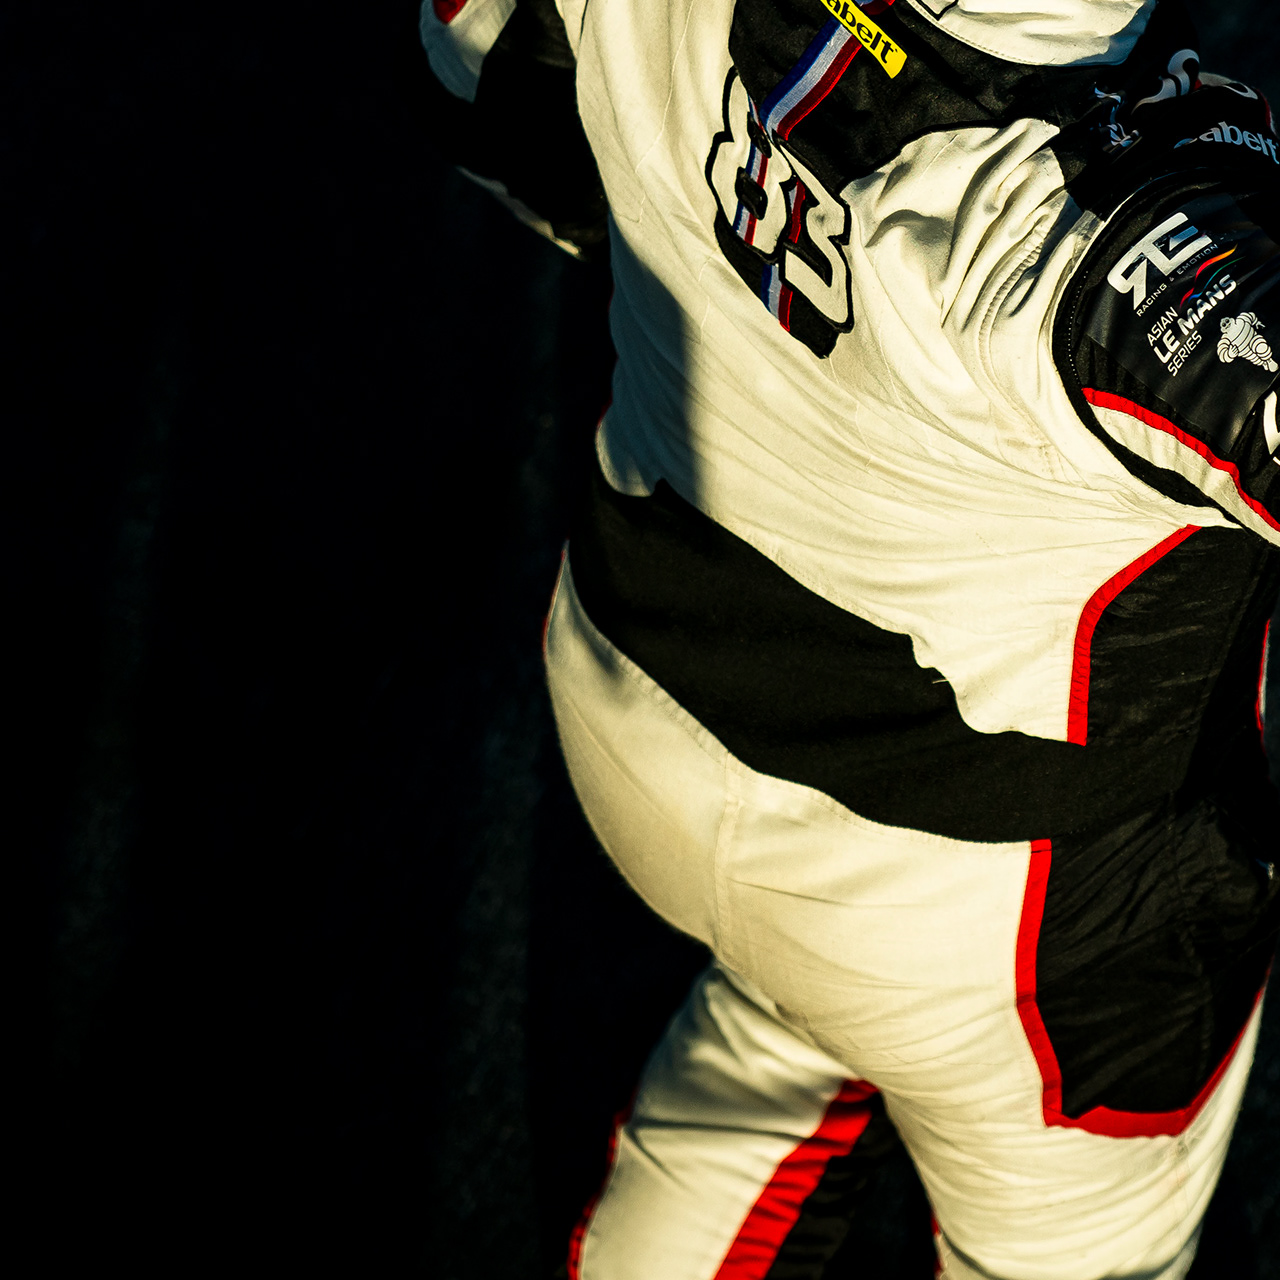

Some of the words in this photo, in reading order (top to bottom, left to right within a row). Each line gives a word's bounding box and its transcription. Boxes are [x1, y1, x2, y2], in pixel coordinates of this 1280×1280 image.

[706, 65, 854, 334] 83
[1135, 282, 1169, 318] RACING
[1176, 243, 1219, 276] EMOTION
[1146, 306, 1179, 348] ASIAN
[1153, 329, 1182, 365] LE
[1177, 273, 1237, 336] MANS
[1167, 330, 1204, 378] SERIES
